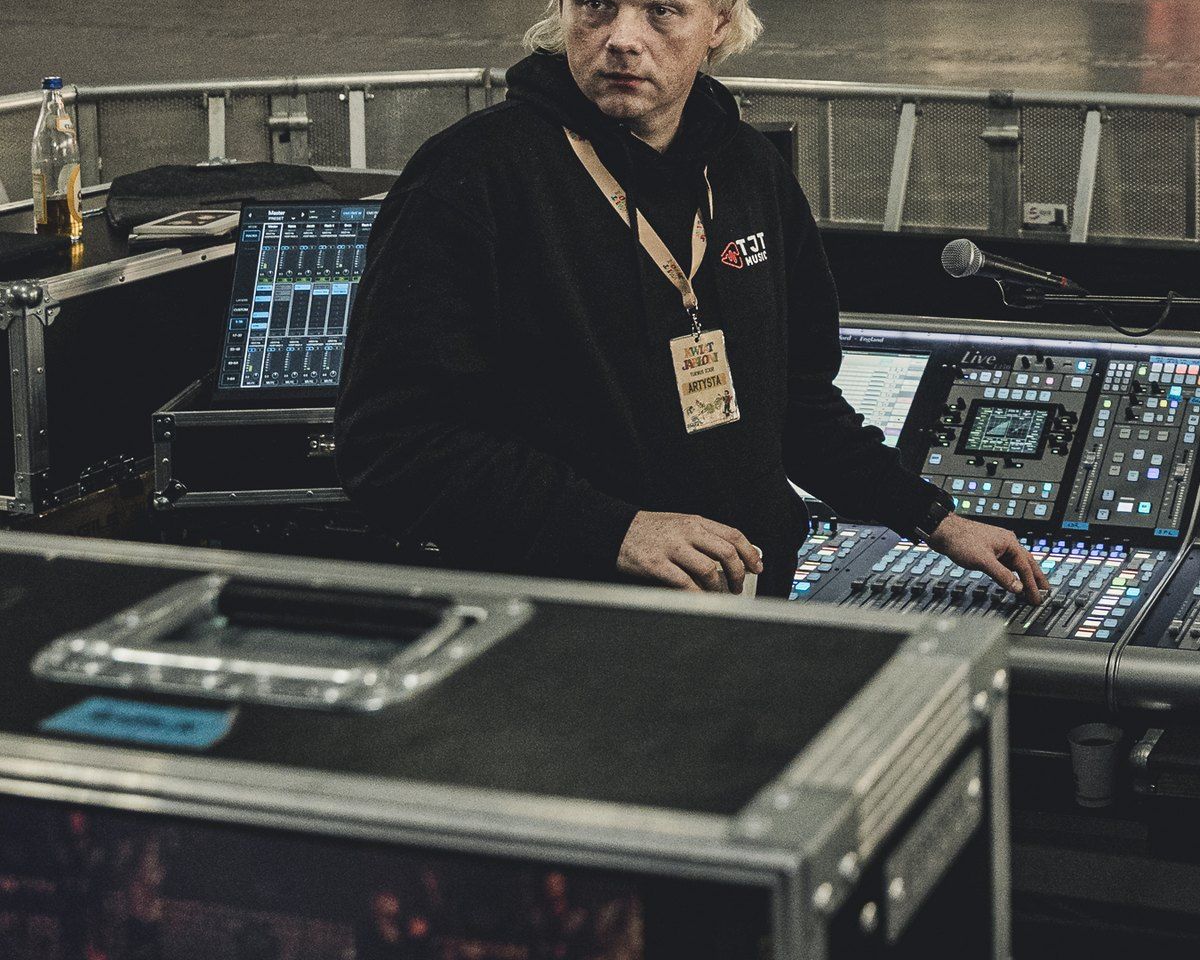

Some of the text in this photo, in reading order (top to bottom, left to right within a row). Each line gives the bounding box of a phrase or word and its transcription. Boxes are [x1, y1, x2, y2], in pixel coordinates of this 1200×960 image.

[736, 232, 765, 257] TJT
[744, 250, 768, 267] MUSIC
[859, 336, 884, 344] England
[960, 351, 997, 365] Live
[688, 375, 722, 394] ARTYSTA
